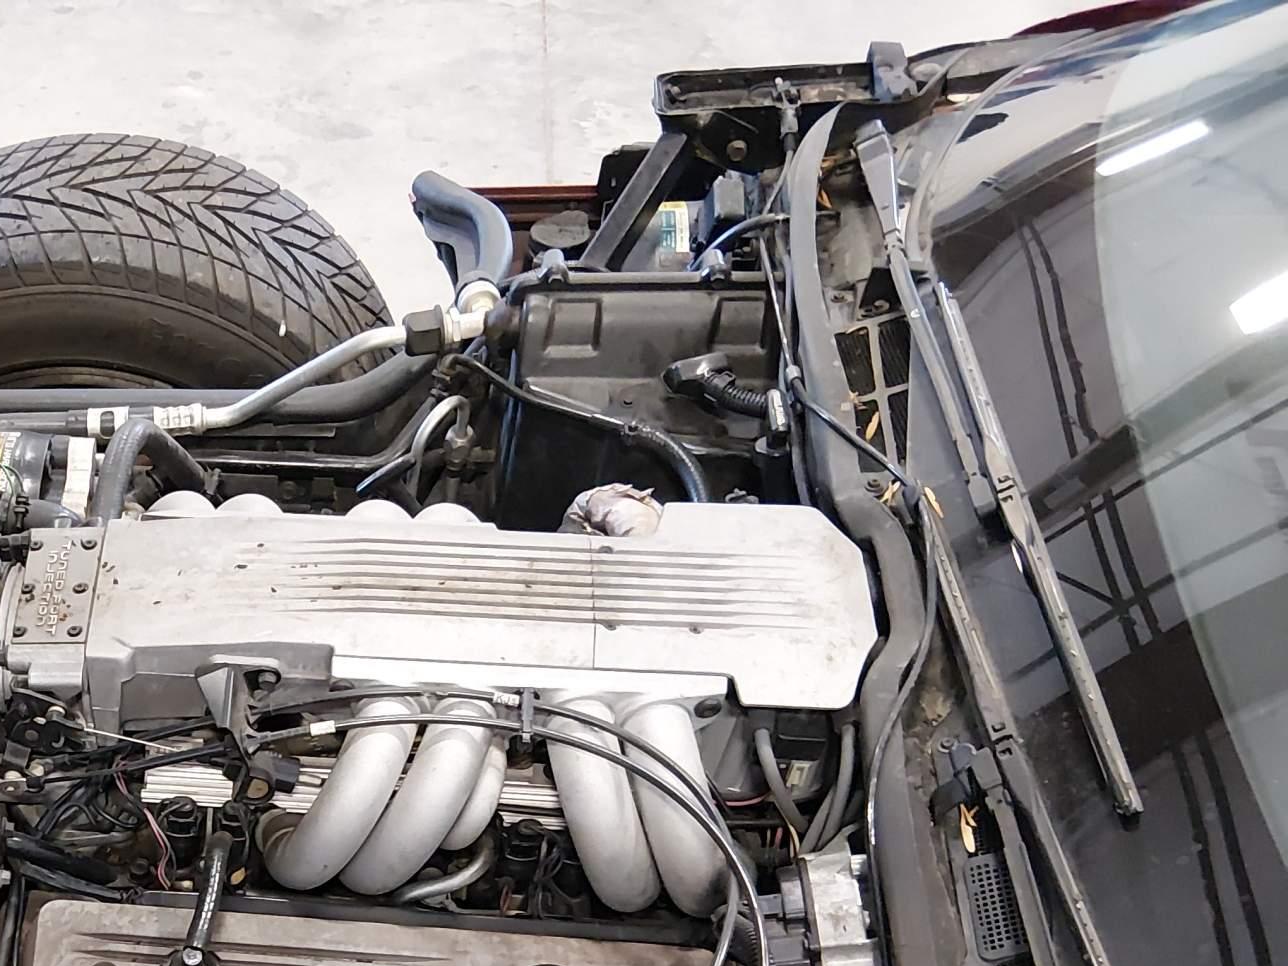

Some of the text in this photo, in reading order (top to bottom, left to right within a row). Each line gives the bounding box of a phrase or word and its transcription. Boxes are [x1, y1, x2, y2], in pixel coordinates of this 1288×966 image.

[37, 551, 55, 626] INJECTION
[45, 540, 71, 634] TUNED PORT
